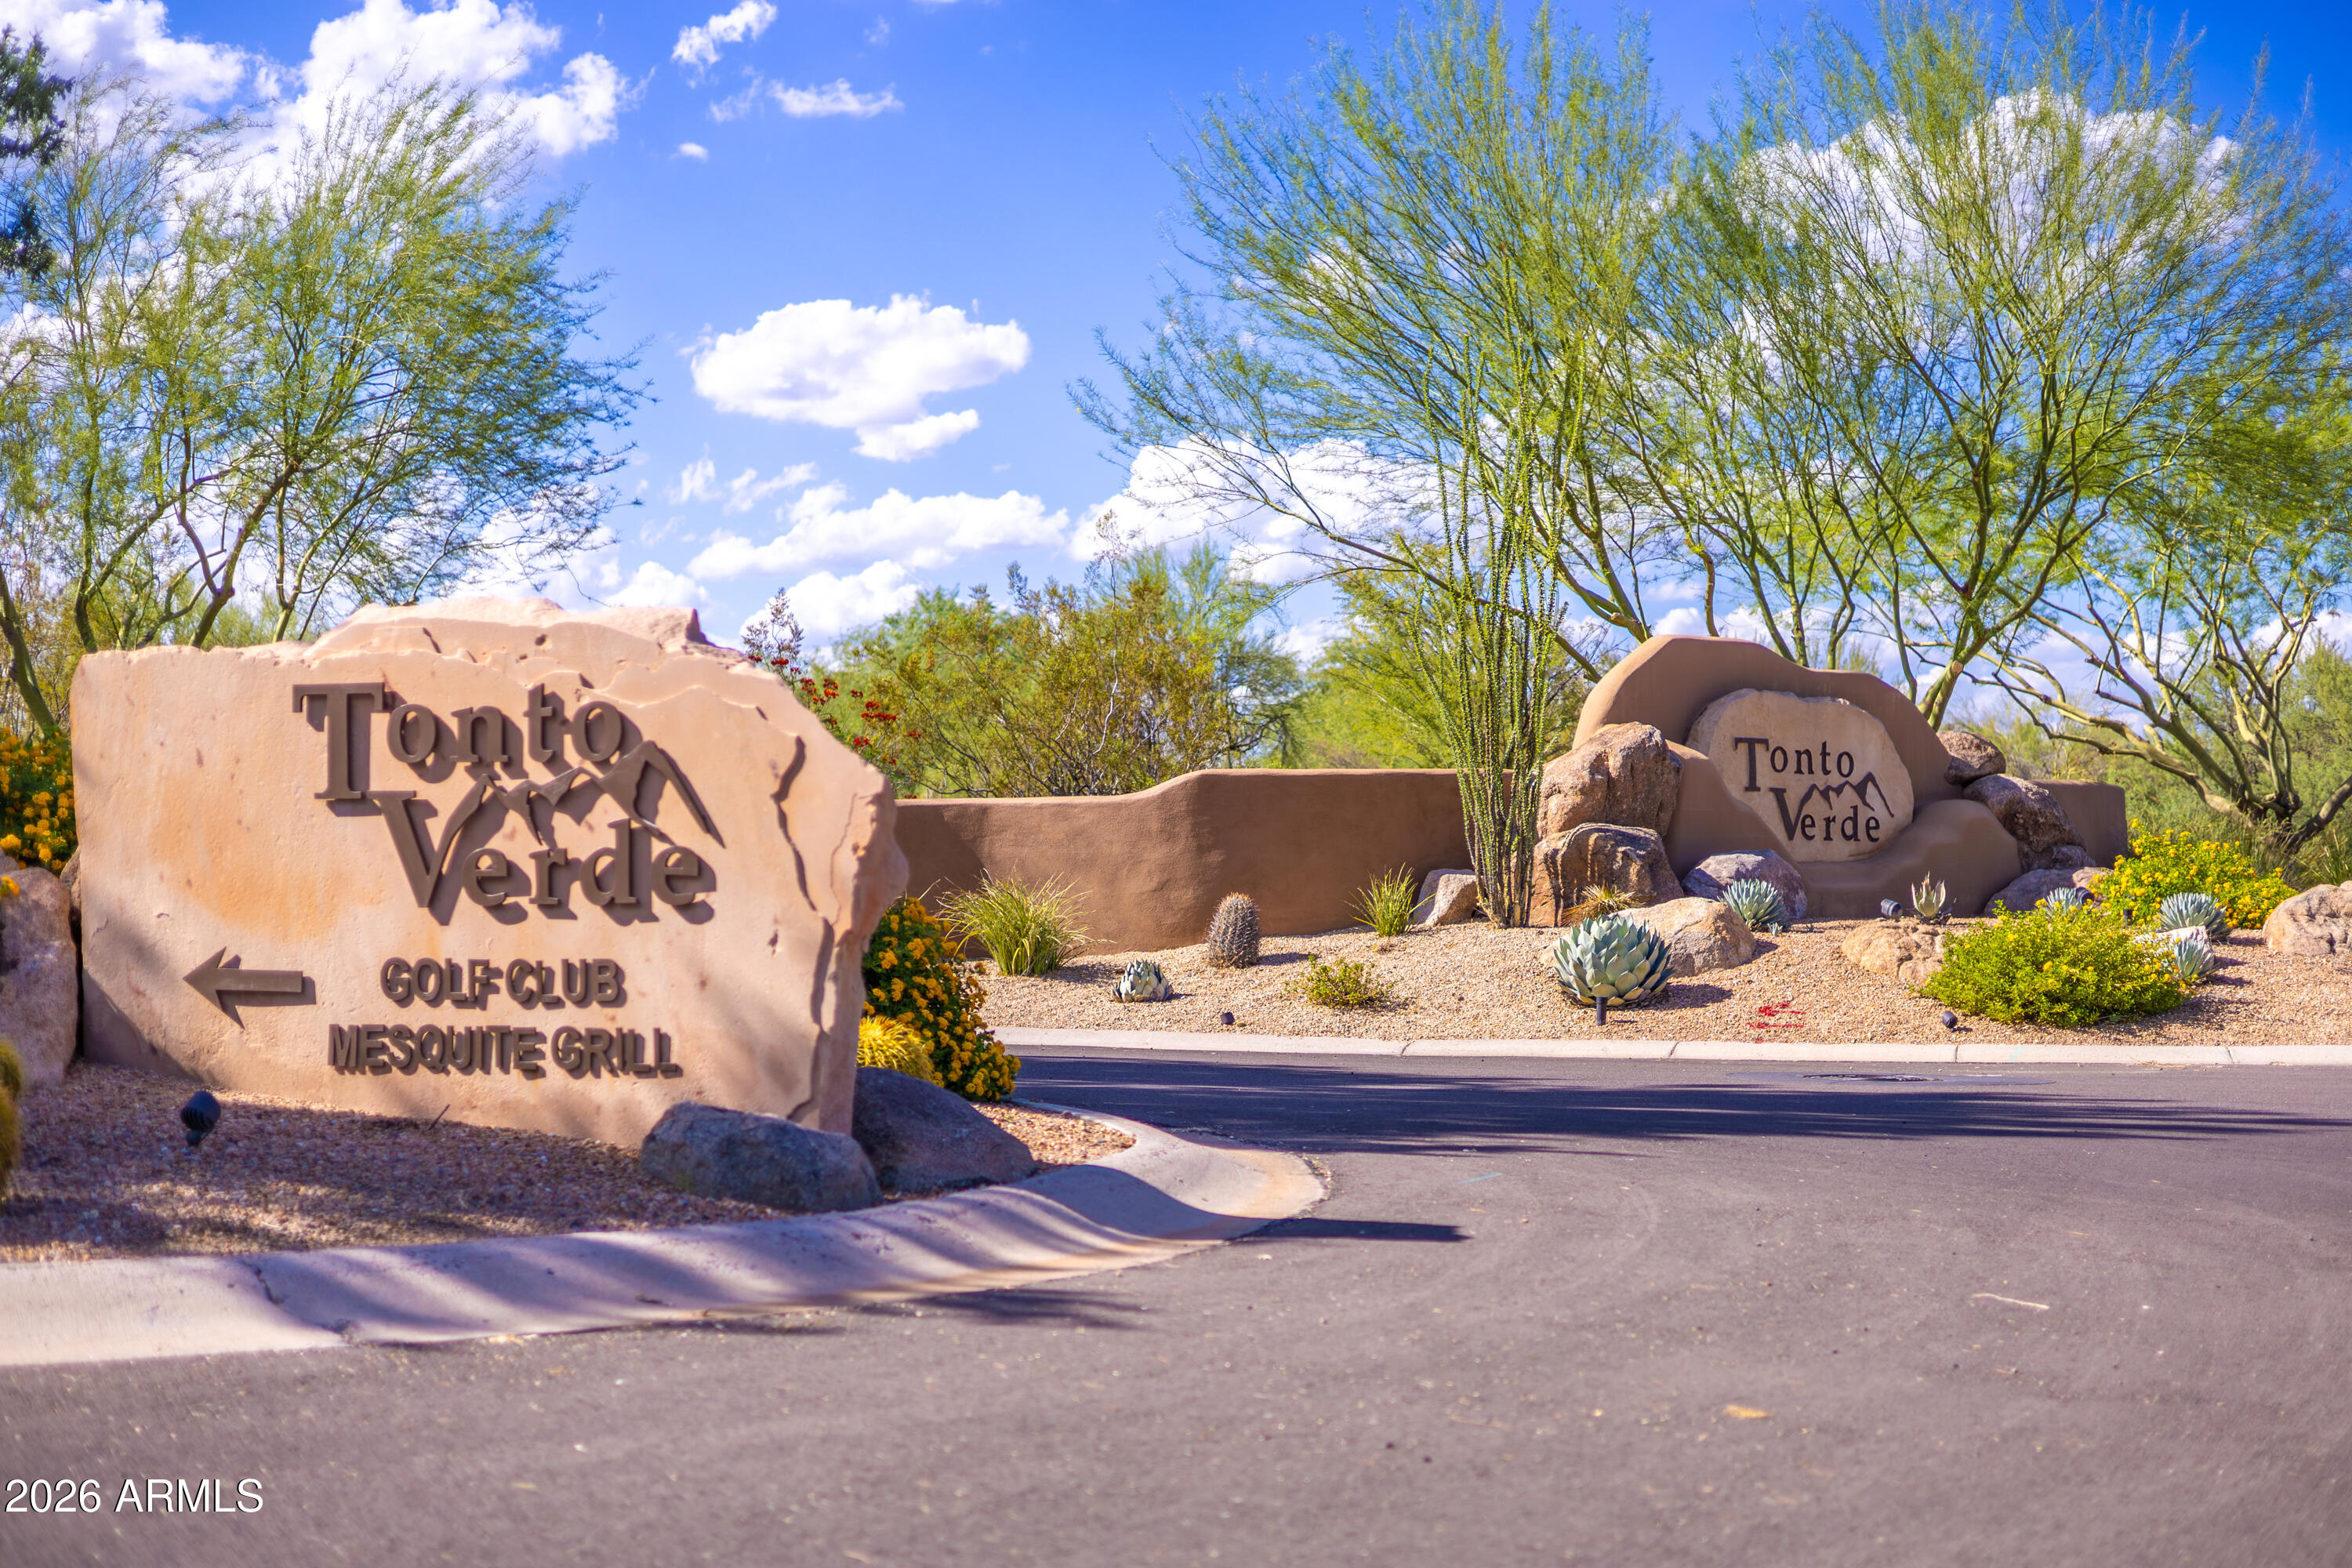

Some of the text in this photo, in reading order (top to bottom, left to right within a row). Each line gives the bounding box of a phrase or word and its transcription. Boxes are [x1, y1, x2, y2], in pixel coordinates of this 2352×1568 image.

[292, 682, 625, 800] Tonto
[1734, 737, 1855, 792] Tonto
[1768, 786, 1881, 842] Verde
[368, 787, 702, 909] Verde
[380, 957, 625, 1005] GOLF CLUB
[329, 1024, 679, 1074] MESQUITE GRILL
